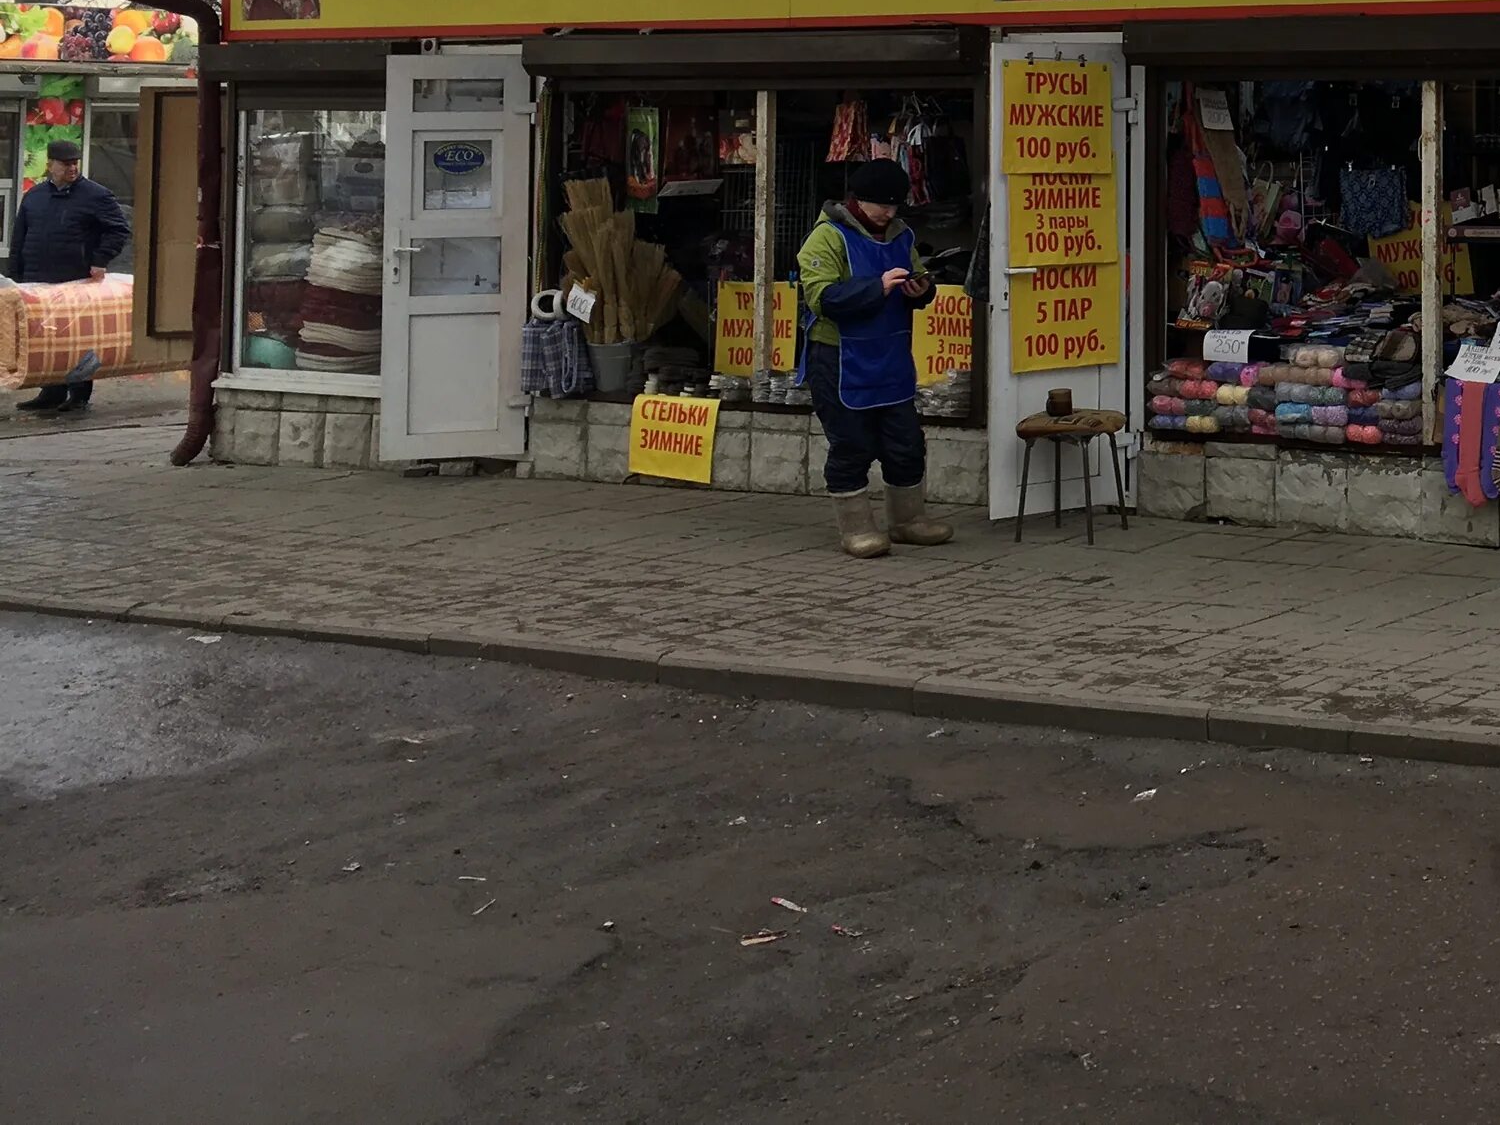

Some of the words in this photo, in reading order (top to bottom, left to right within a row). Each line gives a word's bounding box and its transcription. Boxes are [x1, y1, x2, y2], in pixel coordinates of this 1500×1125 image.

[1025, 71, 1088, 95] ТРУСЫ
[1009, 103, 1104, 127] МУЖСКИЕ
[1016, 136, 1051, 158] 100
[1056, 136, 1097, 164] руб.
[1023, 187, 1102, 210] ЗИМНИЕ
[1036, 213, 1045, 230] 3
[1049, 215, 1088, 233] пары
[1025, 231, 1059, 253] 100
[1063, 229, 1102, 257] руб.
[1032, 264, 1097, 291] НОСКИ
[1036, 301, 1048, 324] 5
[1053, 297, 1093, 322] ПАР
[926, 316, 974, 337] ЗИМН
[937, 338, 945, 354] 3
[949, 343, 972, 360] пар
[1024, 333, 1059, 357] 100
[1064, 328, 1106, 360] руб.
[728, 347, 753, 366] 100
[926, 355, 955, 375] 100
[640, 399, 710, 428] СТЕЛЬКИ
[639, 428, 703, 456] ЗИМНИЕ
